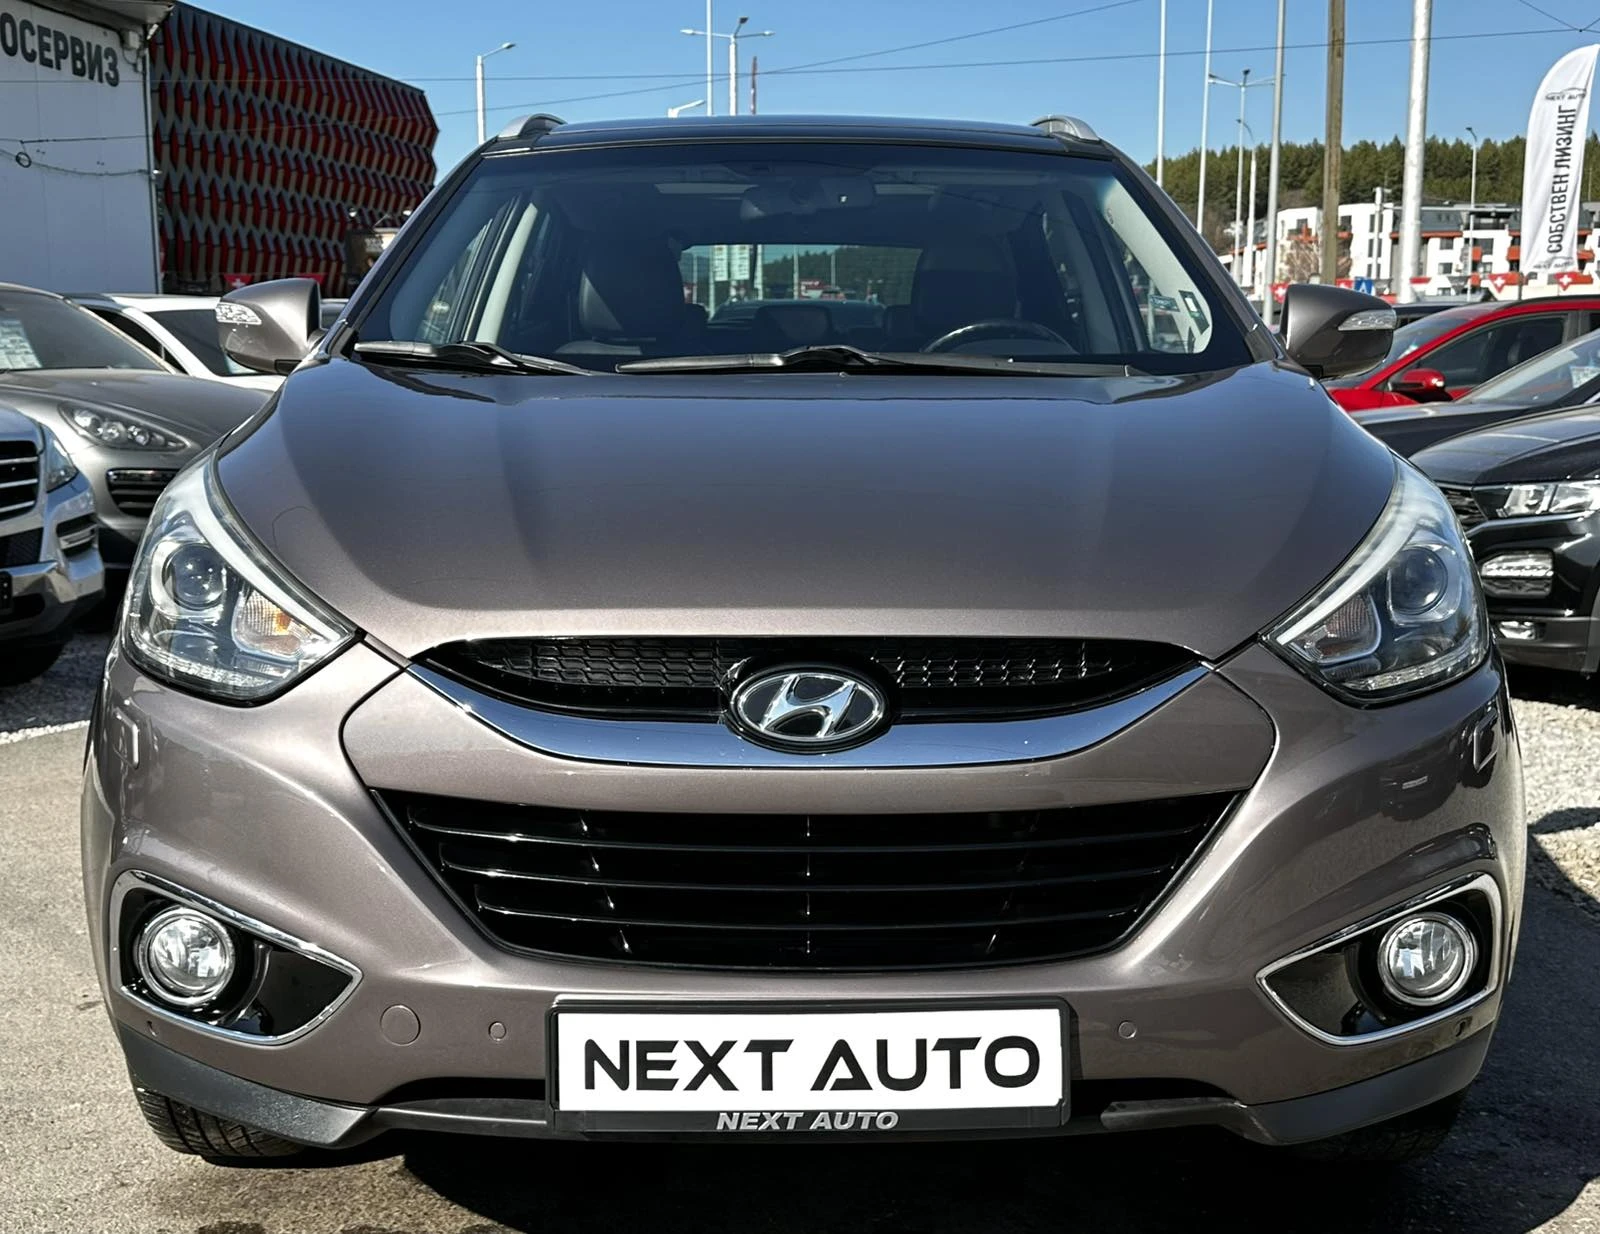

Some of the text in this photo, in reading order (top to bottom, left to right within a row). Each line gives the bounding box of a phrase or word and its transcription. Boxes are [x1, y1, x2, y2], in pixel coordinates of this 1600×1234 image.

[0, 12, 119, 87] ОСЕРВИЗ
[1546, 105, 1576, 254] СОБСТВЕН ЛИЗИНГ
[584, 1035, 1040, 1092] NEXT AUTO
[716, 1111, 899, 1131] NEXT AUTO
